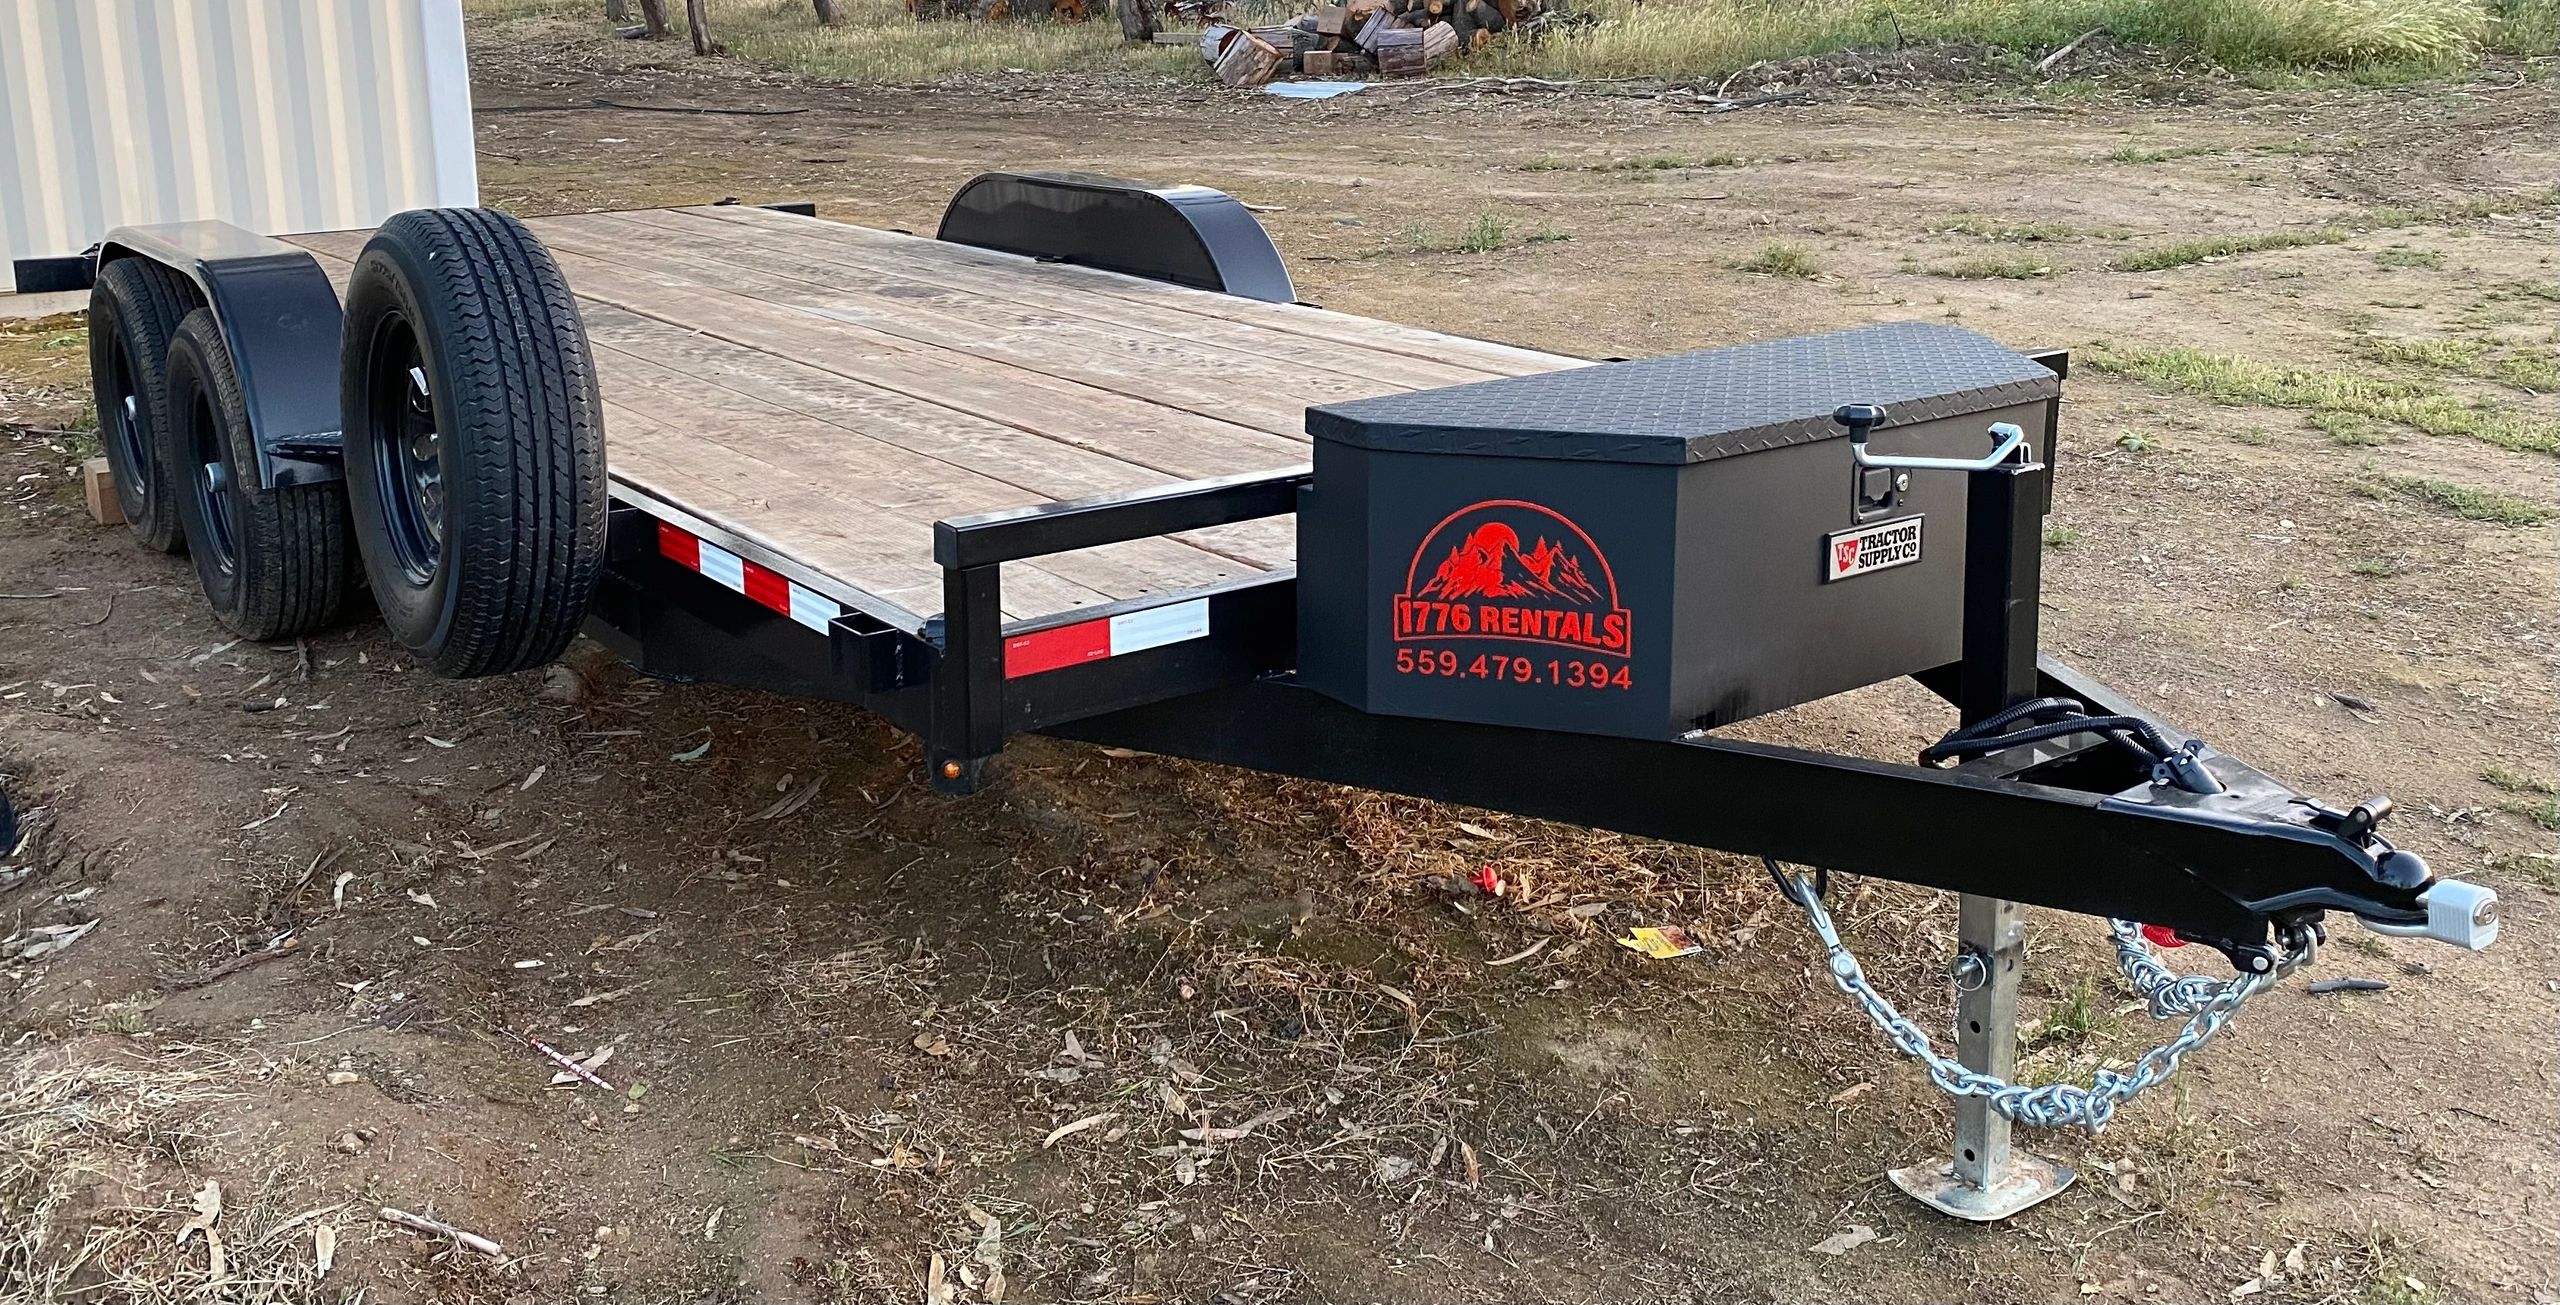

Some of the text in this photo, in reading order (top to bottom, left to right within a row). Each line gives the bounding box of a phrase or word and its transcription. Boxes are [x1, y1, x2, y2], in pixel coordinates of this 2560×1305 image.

[1860, 525, 1916, 551] TRACTOR
[1859, 545, 1901, 568] SUPPLY
[1400, 601, 1623, 649] 1776 RENTALS
[1396, 648, 1632, 690] 559.479.1394
